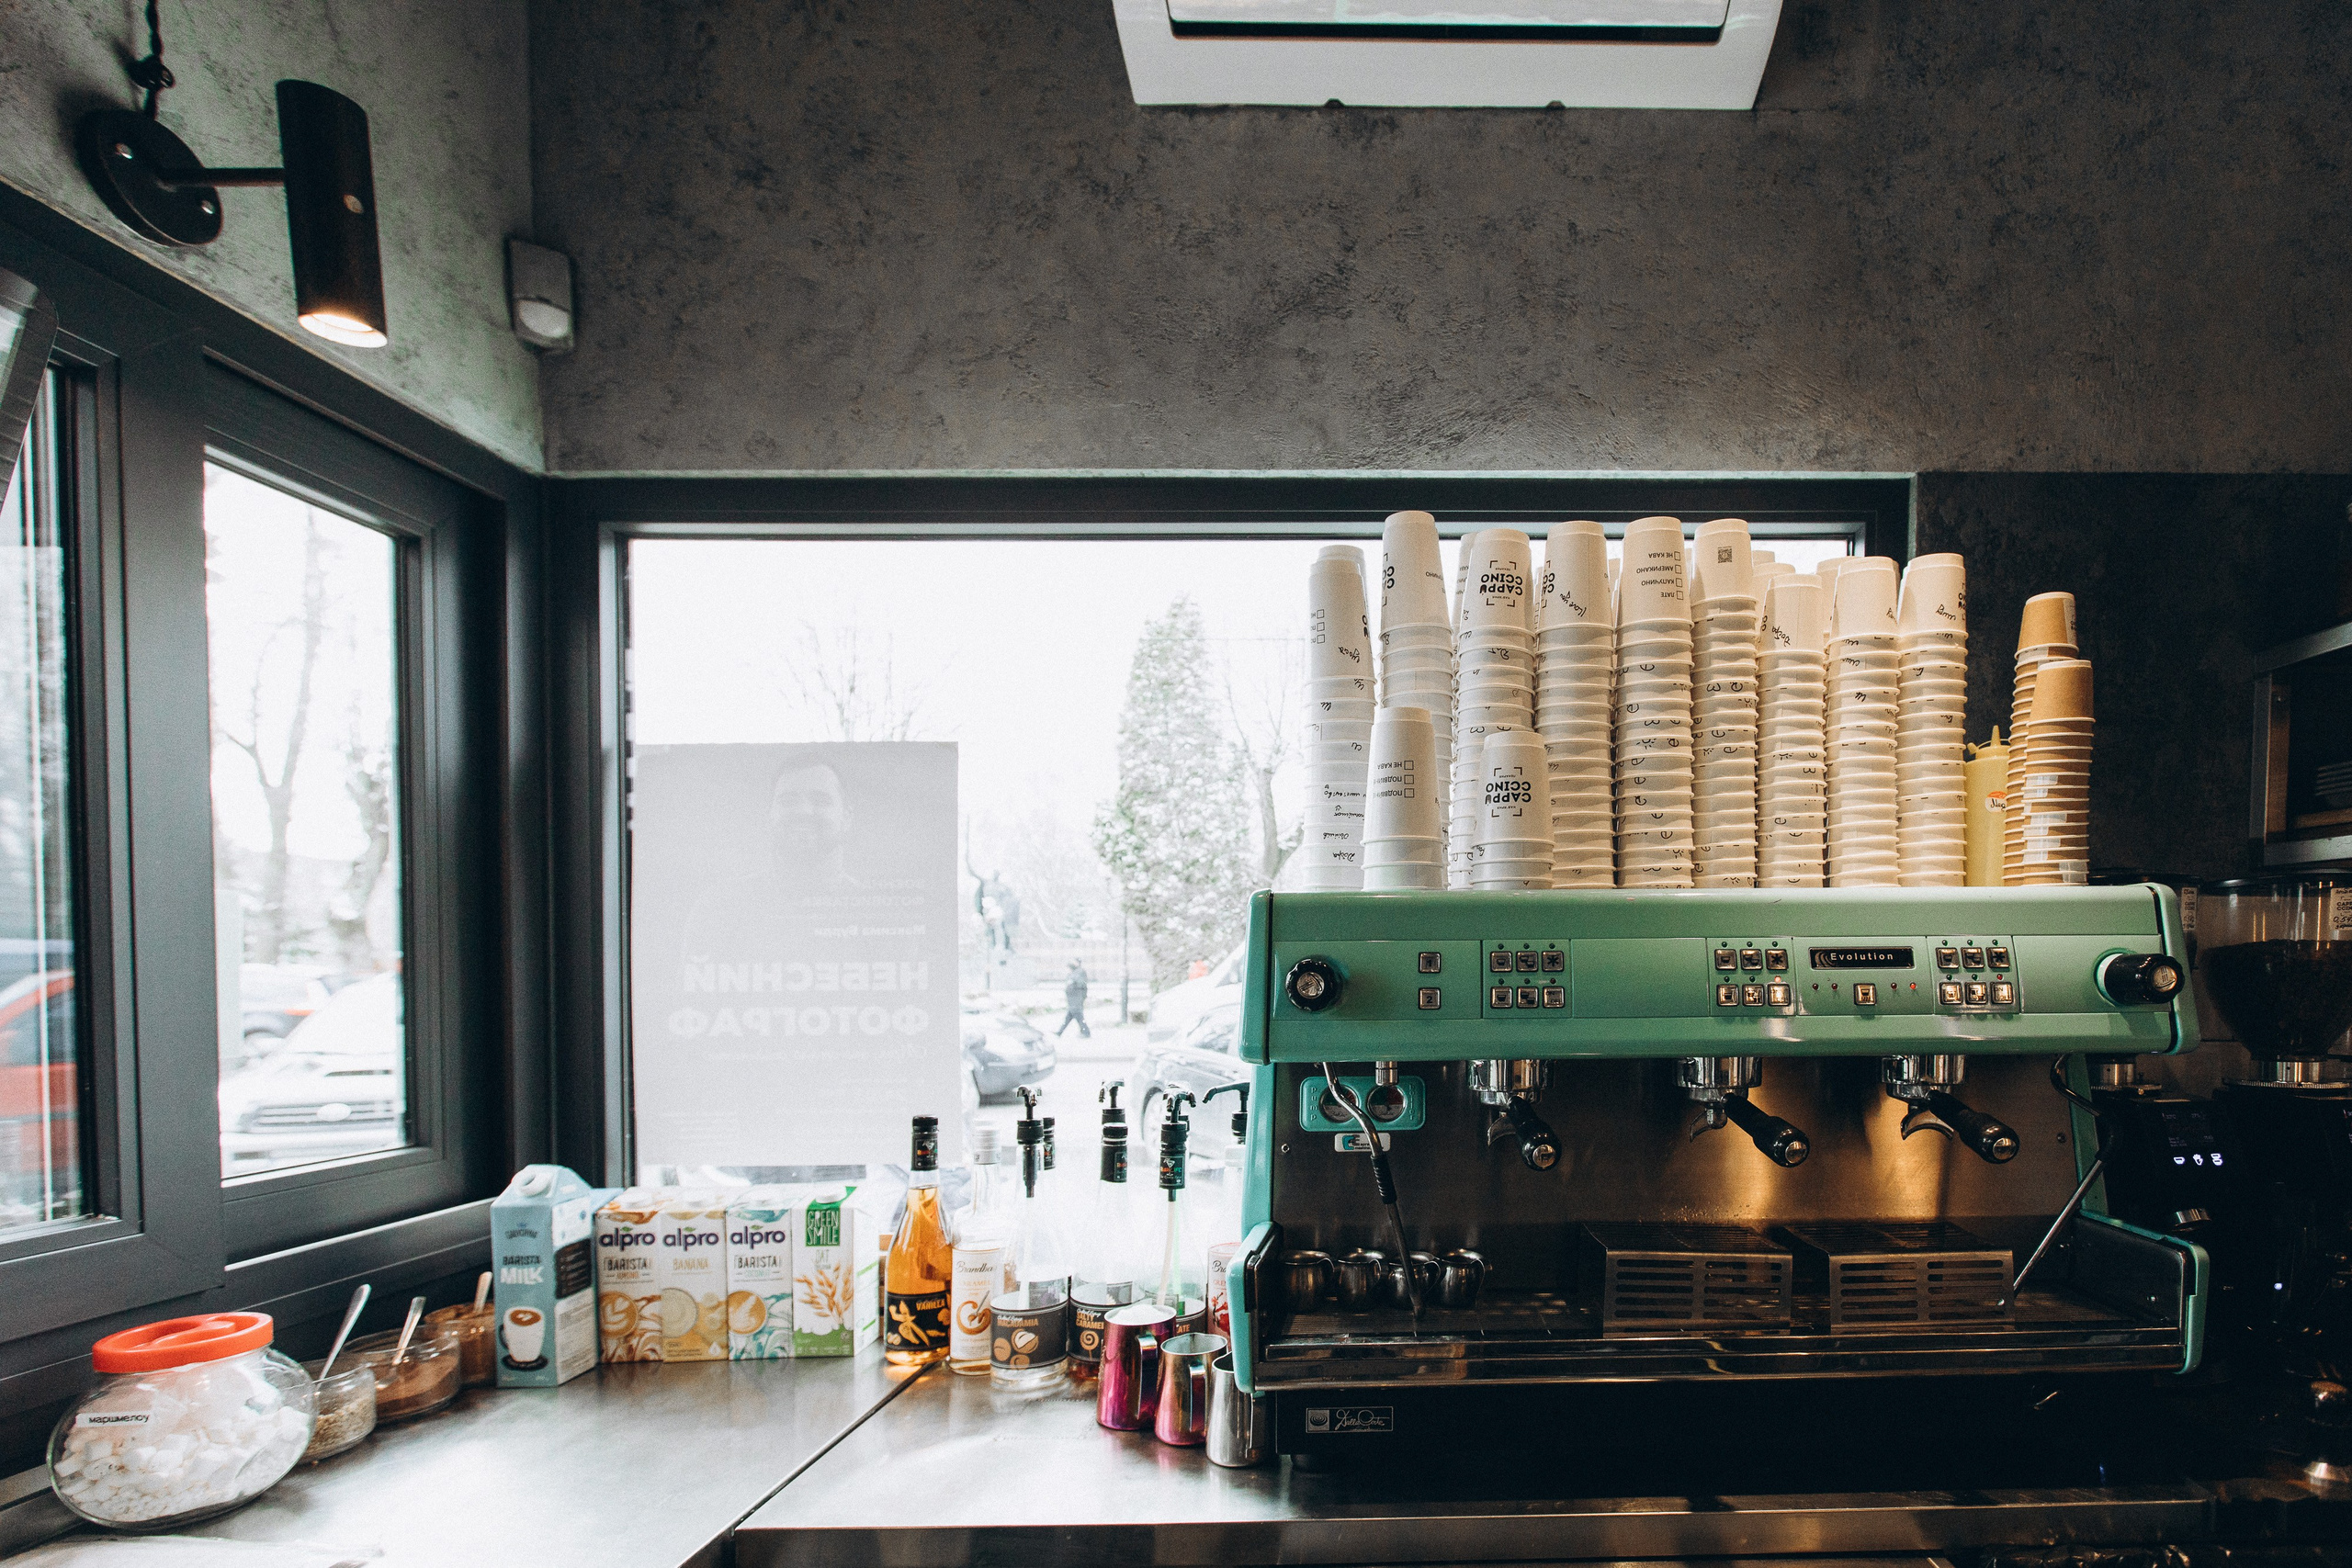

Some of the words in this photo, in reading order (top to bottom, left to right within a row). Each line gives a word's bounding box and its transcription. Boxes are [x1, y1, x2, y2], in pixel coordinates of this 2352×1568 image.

[1635, 565, 1674, 574] АМЕРИКАНО
[1480, 573, 1522, 585] CCINO
[1640, 578, 1675, 587] КАПУЧИНО
[1479, 583, 1523, 596] CAPPU
[1486, 781, 1532, 793] CCINO
[1485, 792, 1532, 806] CAPPU
[1830, 952, 1894, 962] Evolution
[1425, 995, 1433, 1005] 2
[1310, 1086, 1318, 1121] pump
[807, 1210, 839, 1227] GREEN
[599, 1227, 656, 1252] alpro
[663, 1227, 719, 1252] alpro
[730, 1226, 786, 1250] alpro
[807, 1227, 839, 1246] SMILE
[502, 1255, 541, 1266] BARISTA
[606, 1258, 647, 1270] BARISTA
[673, 1258, 709, 1270] BANANA
[738, 1256, 776, 1269] BARISTA
[500, 1267, 544, 1285] MILK
[916, 1299, 946, 1312] VANILLA
[997, 1319, 1039, 1328] MACADAMIA
[1076, 1313, 1094, 1322] SALTY
[88, 1413, 151, 1424] маршмелоу
